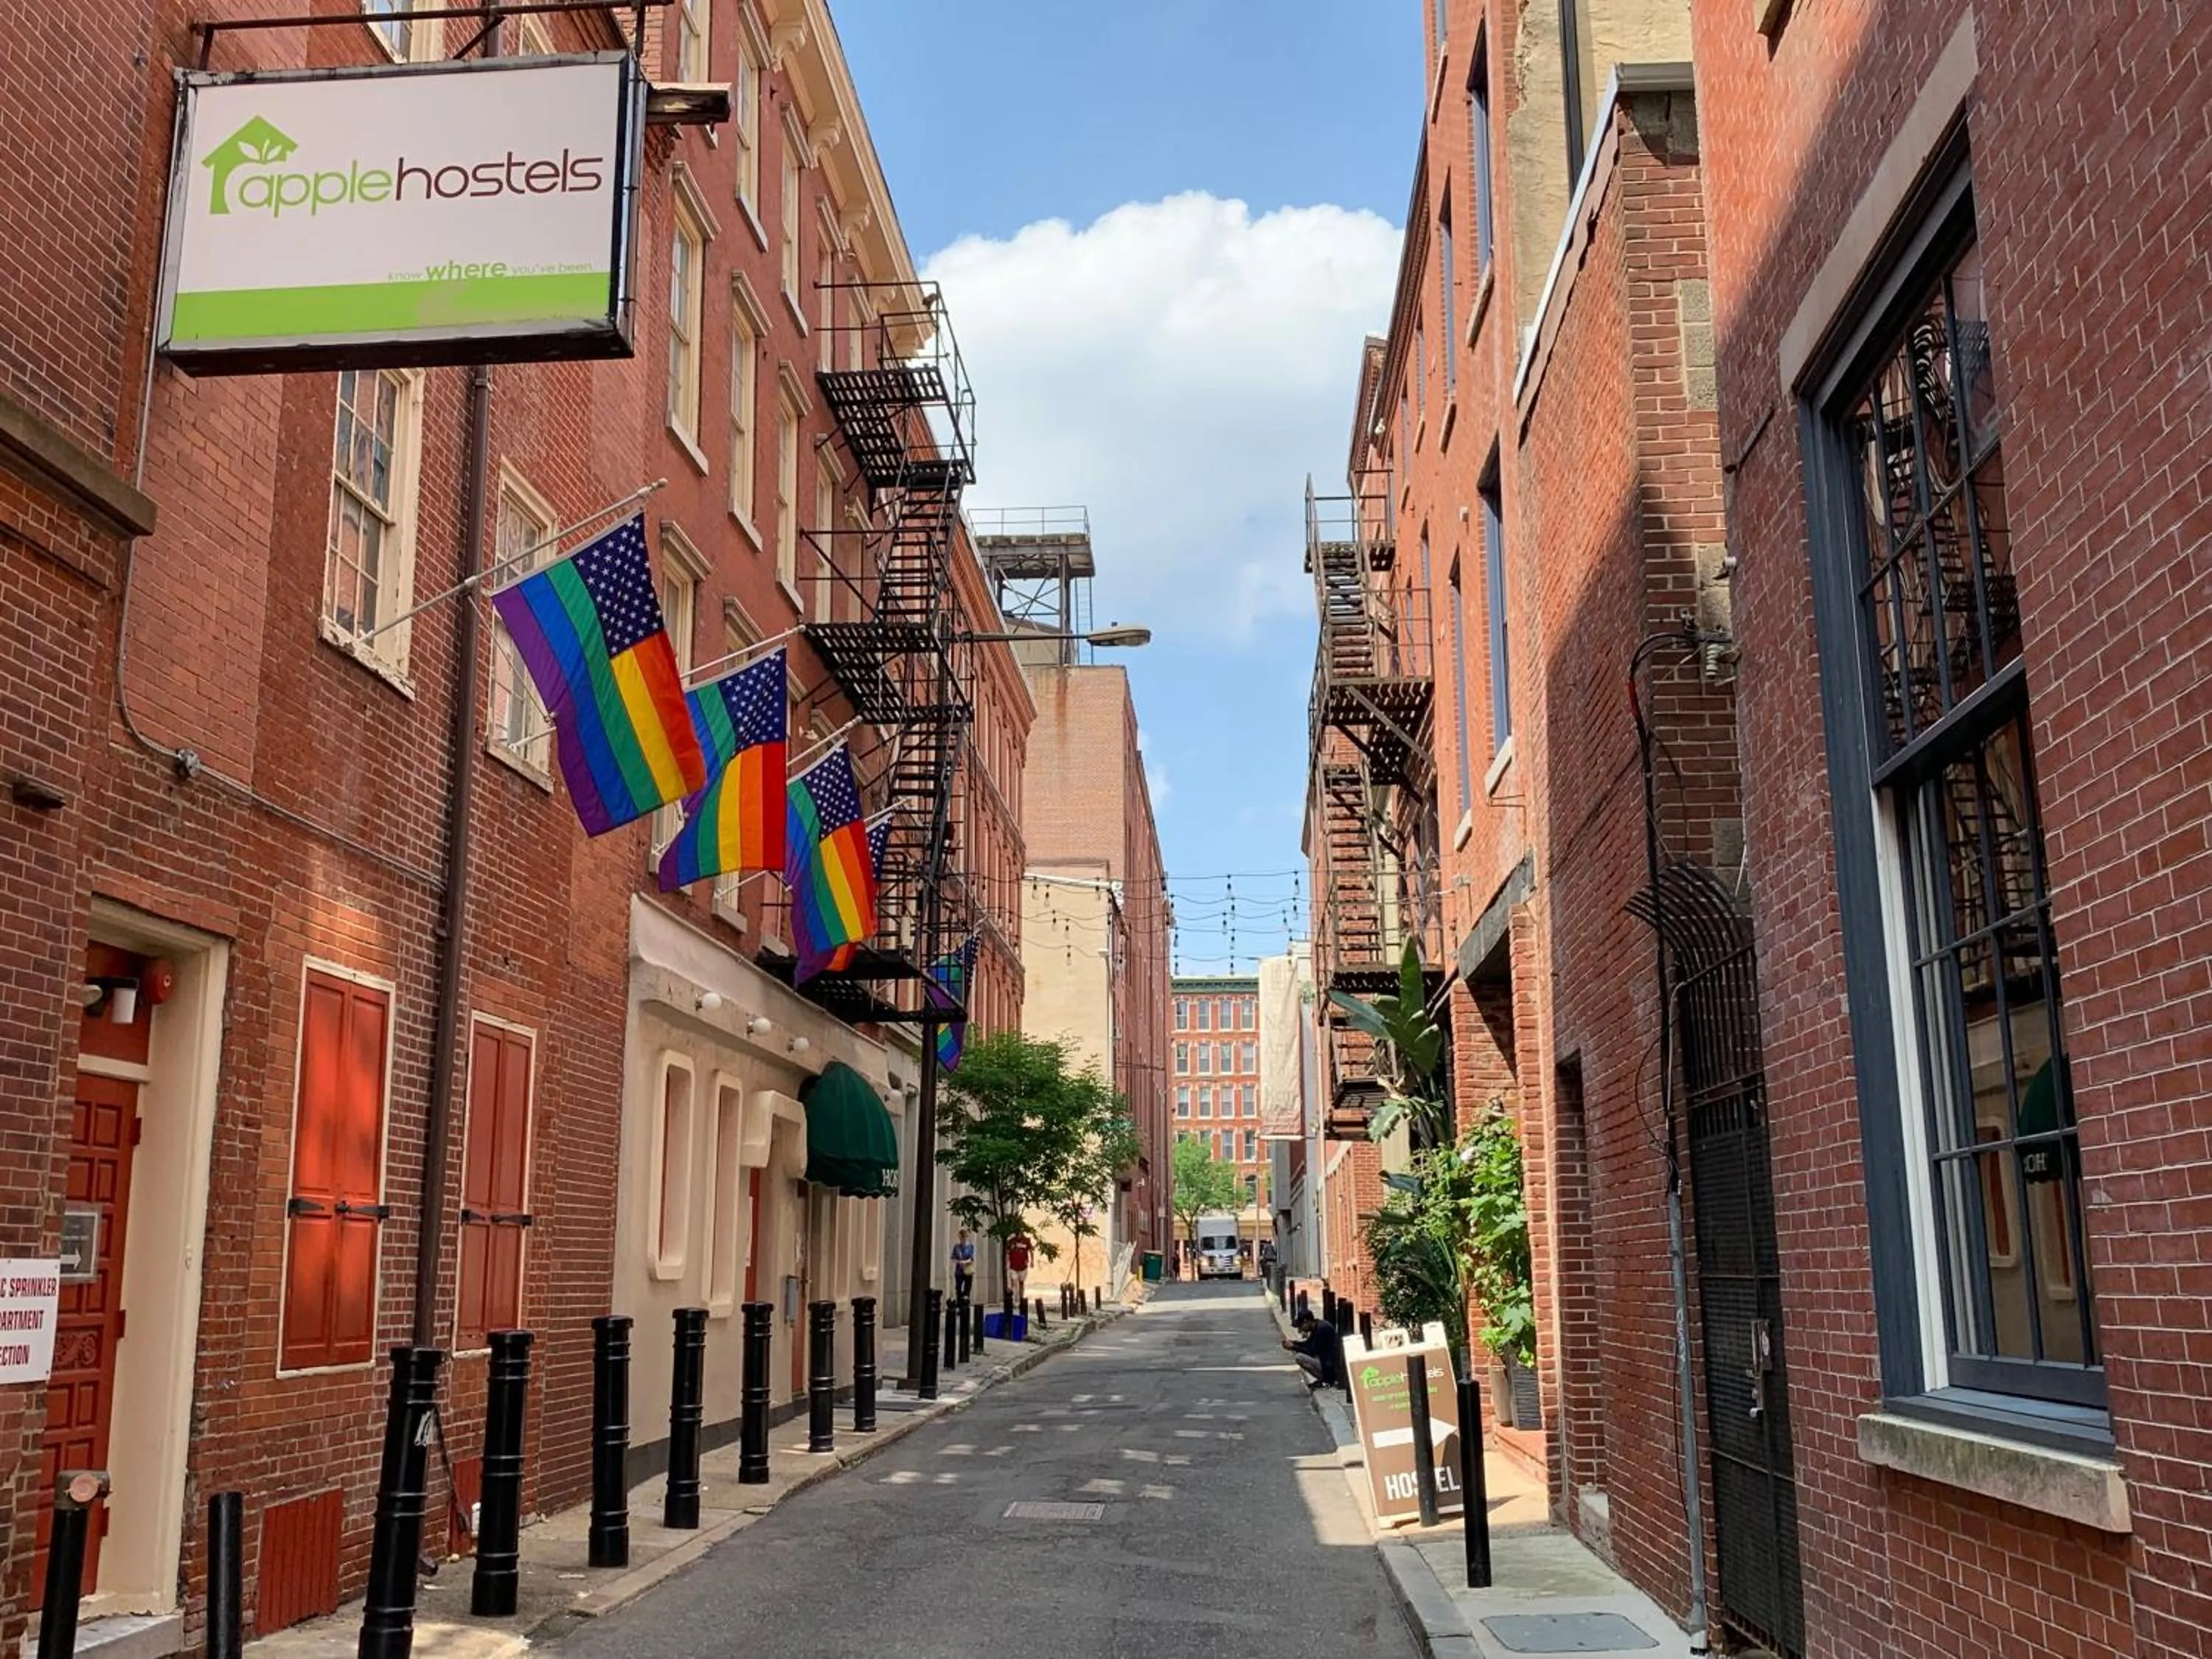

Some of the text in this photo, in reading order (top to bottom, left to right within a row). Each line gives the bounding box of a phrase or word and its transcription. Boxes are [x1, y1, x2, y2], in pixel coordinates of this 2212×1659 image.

[425, 260, 507, 281] where
[9, 1276, 57, 1297] SPRINKLER
[1384, 1466, 1461, 1500] HOSEL
